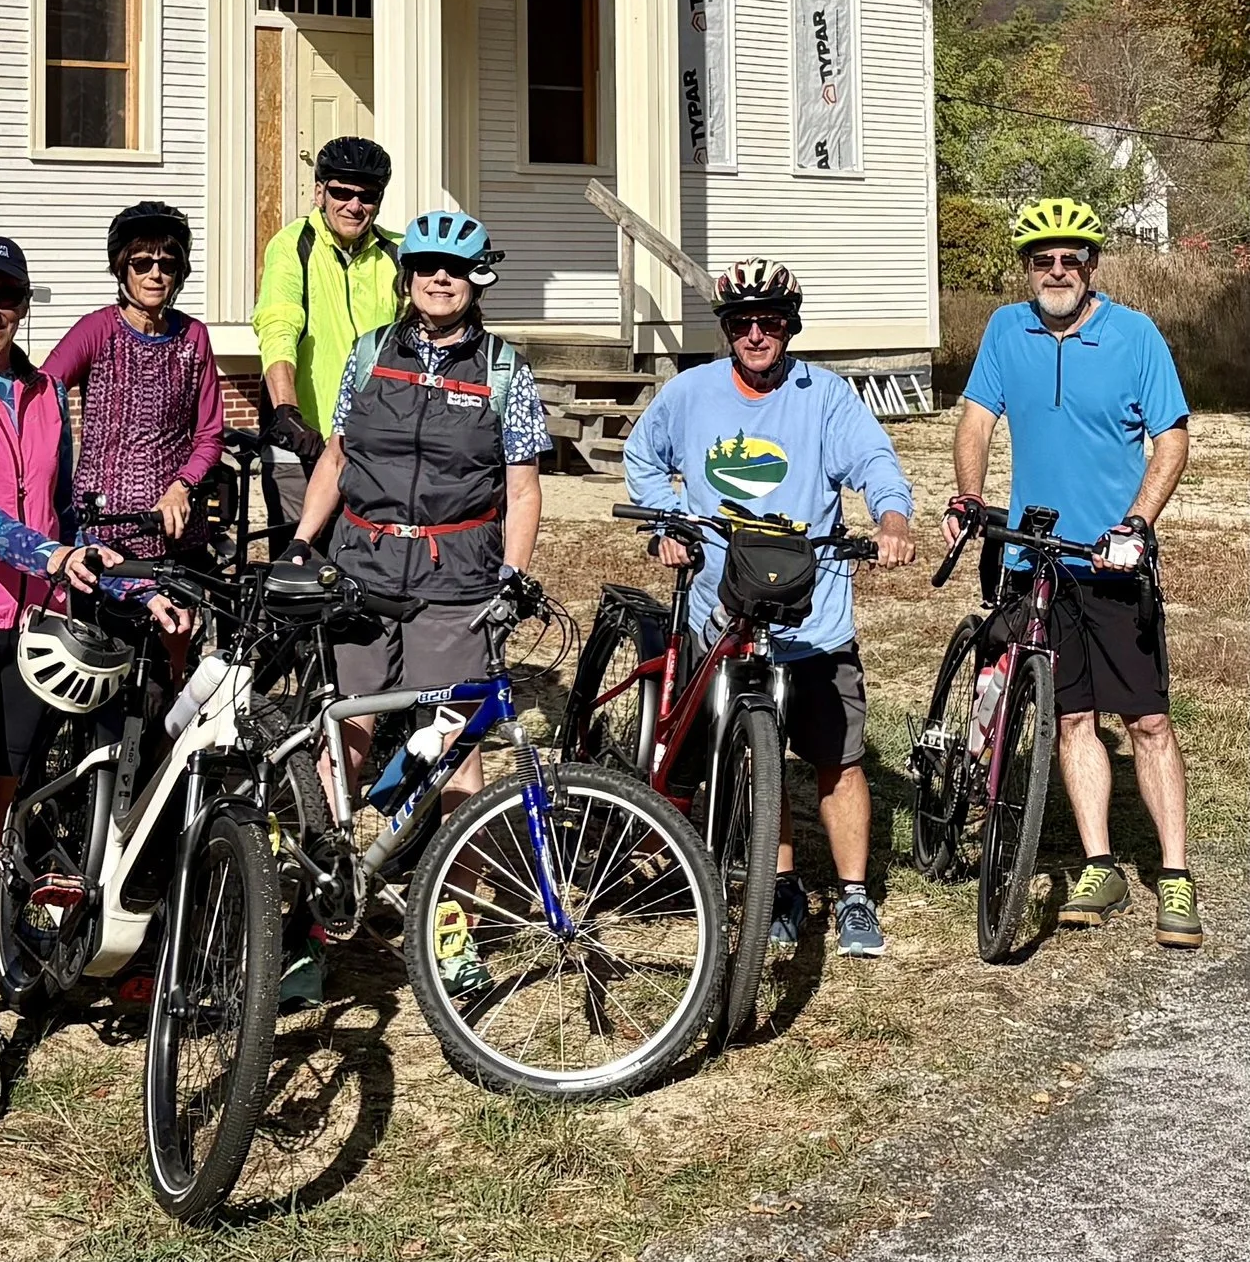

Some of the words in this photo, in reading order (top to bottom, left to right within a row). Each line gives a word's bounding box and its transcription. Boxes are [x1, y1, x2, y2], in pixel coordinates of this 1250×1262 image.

[813, 9, 833, 84] TYPAR
[683, 68, 706, 147] TYPAR
[419, 689, 451, 703] 820
